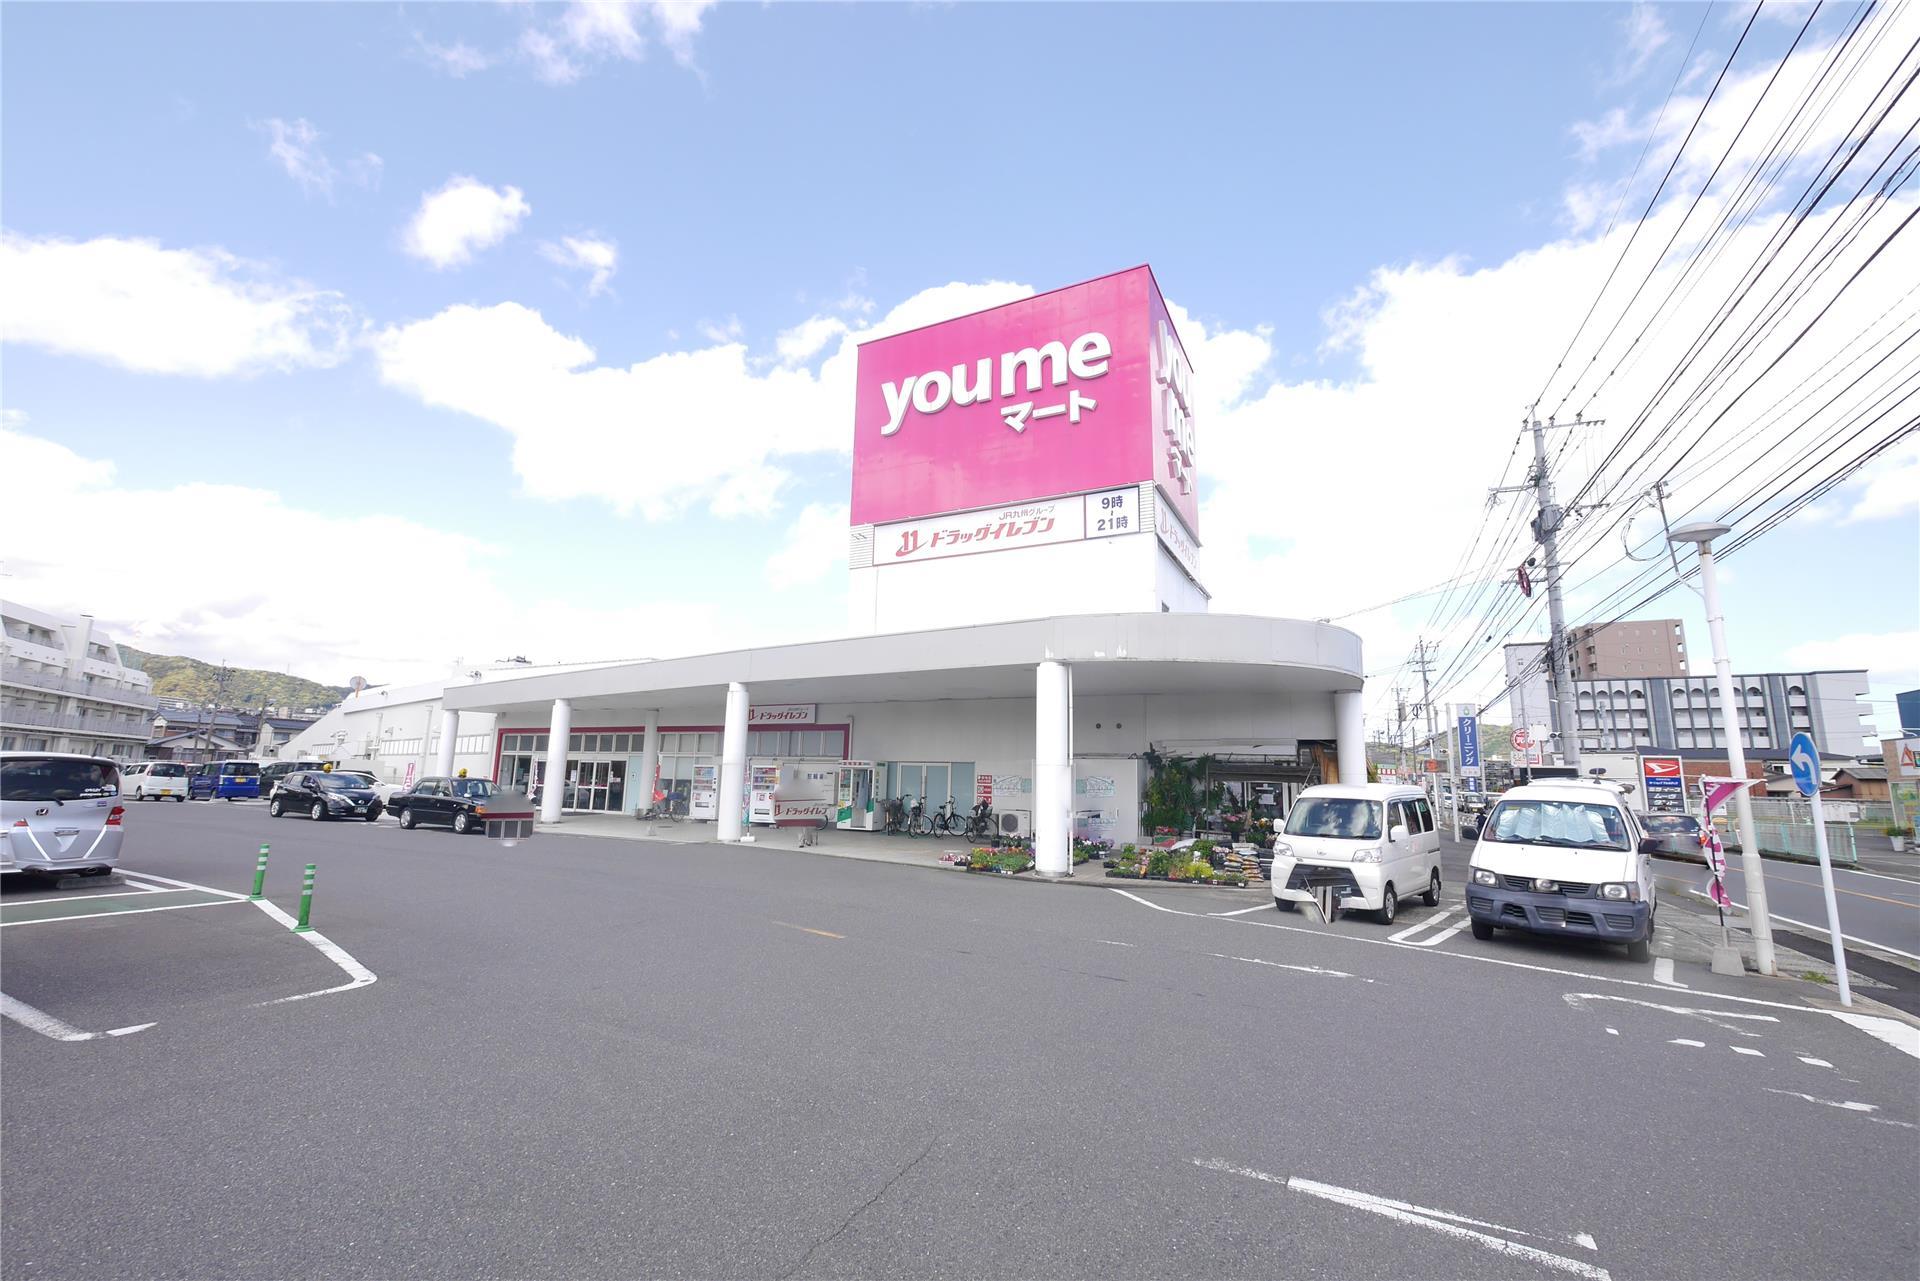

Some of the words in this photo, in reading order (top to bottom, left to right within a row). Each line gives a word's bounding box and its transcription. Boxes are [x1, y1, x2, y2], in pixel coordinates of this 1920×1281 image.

[880, 357, 993, 437] you
[1000, 331, 1112, 396] me
[1000, 389, 1099, 434] マート
[998, 503, 1056, 522] JR九州グループ
[1101, 494, 1124, 510] 9時
[930, 515, 1056, 549] ドラッグイレブン
[1096, 515, 1129, 532] 21時
[1462, 718, 1475, 766] クリーニング
